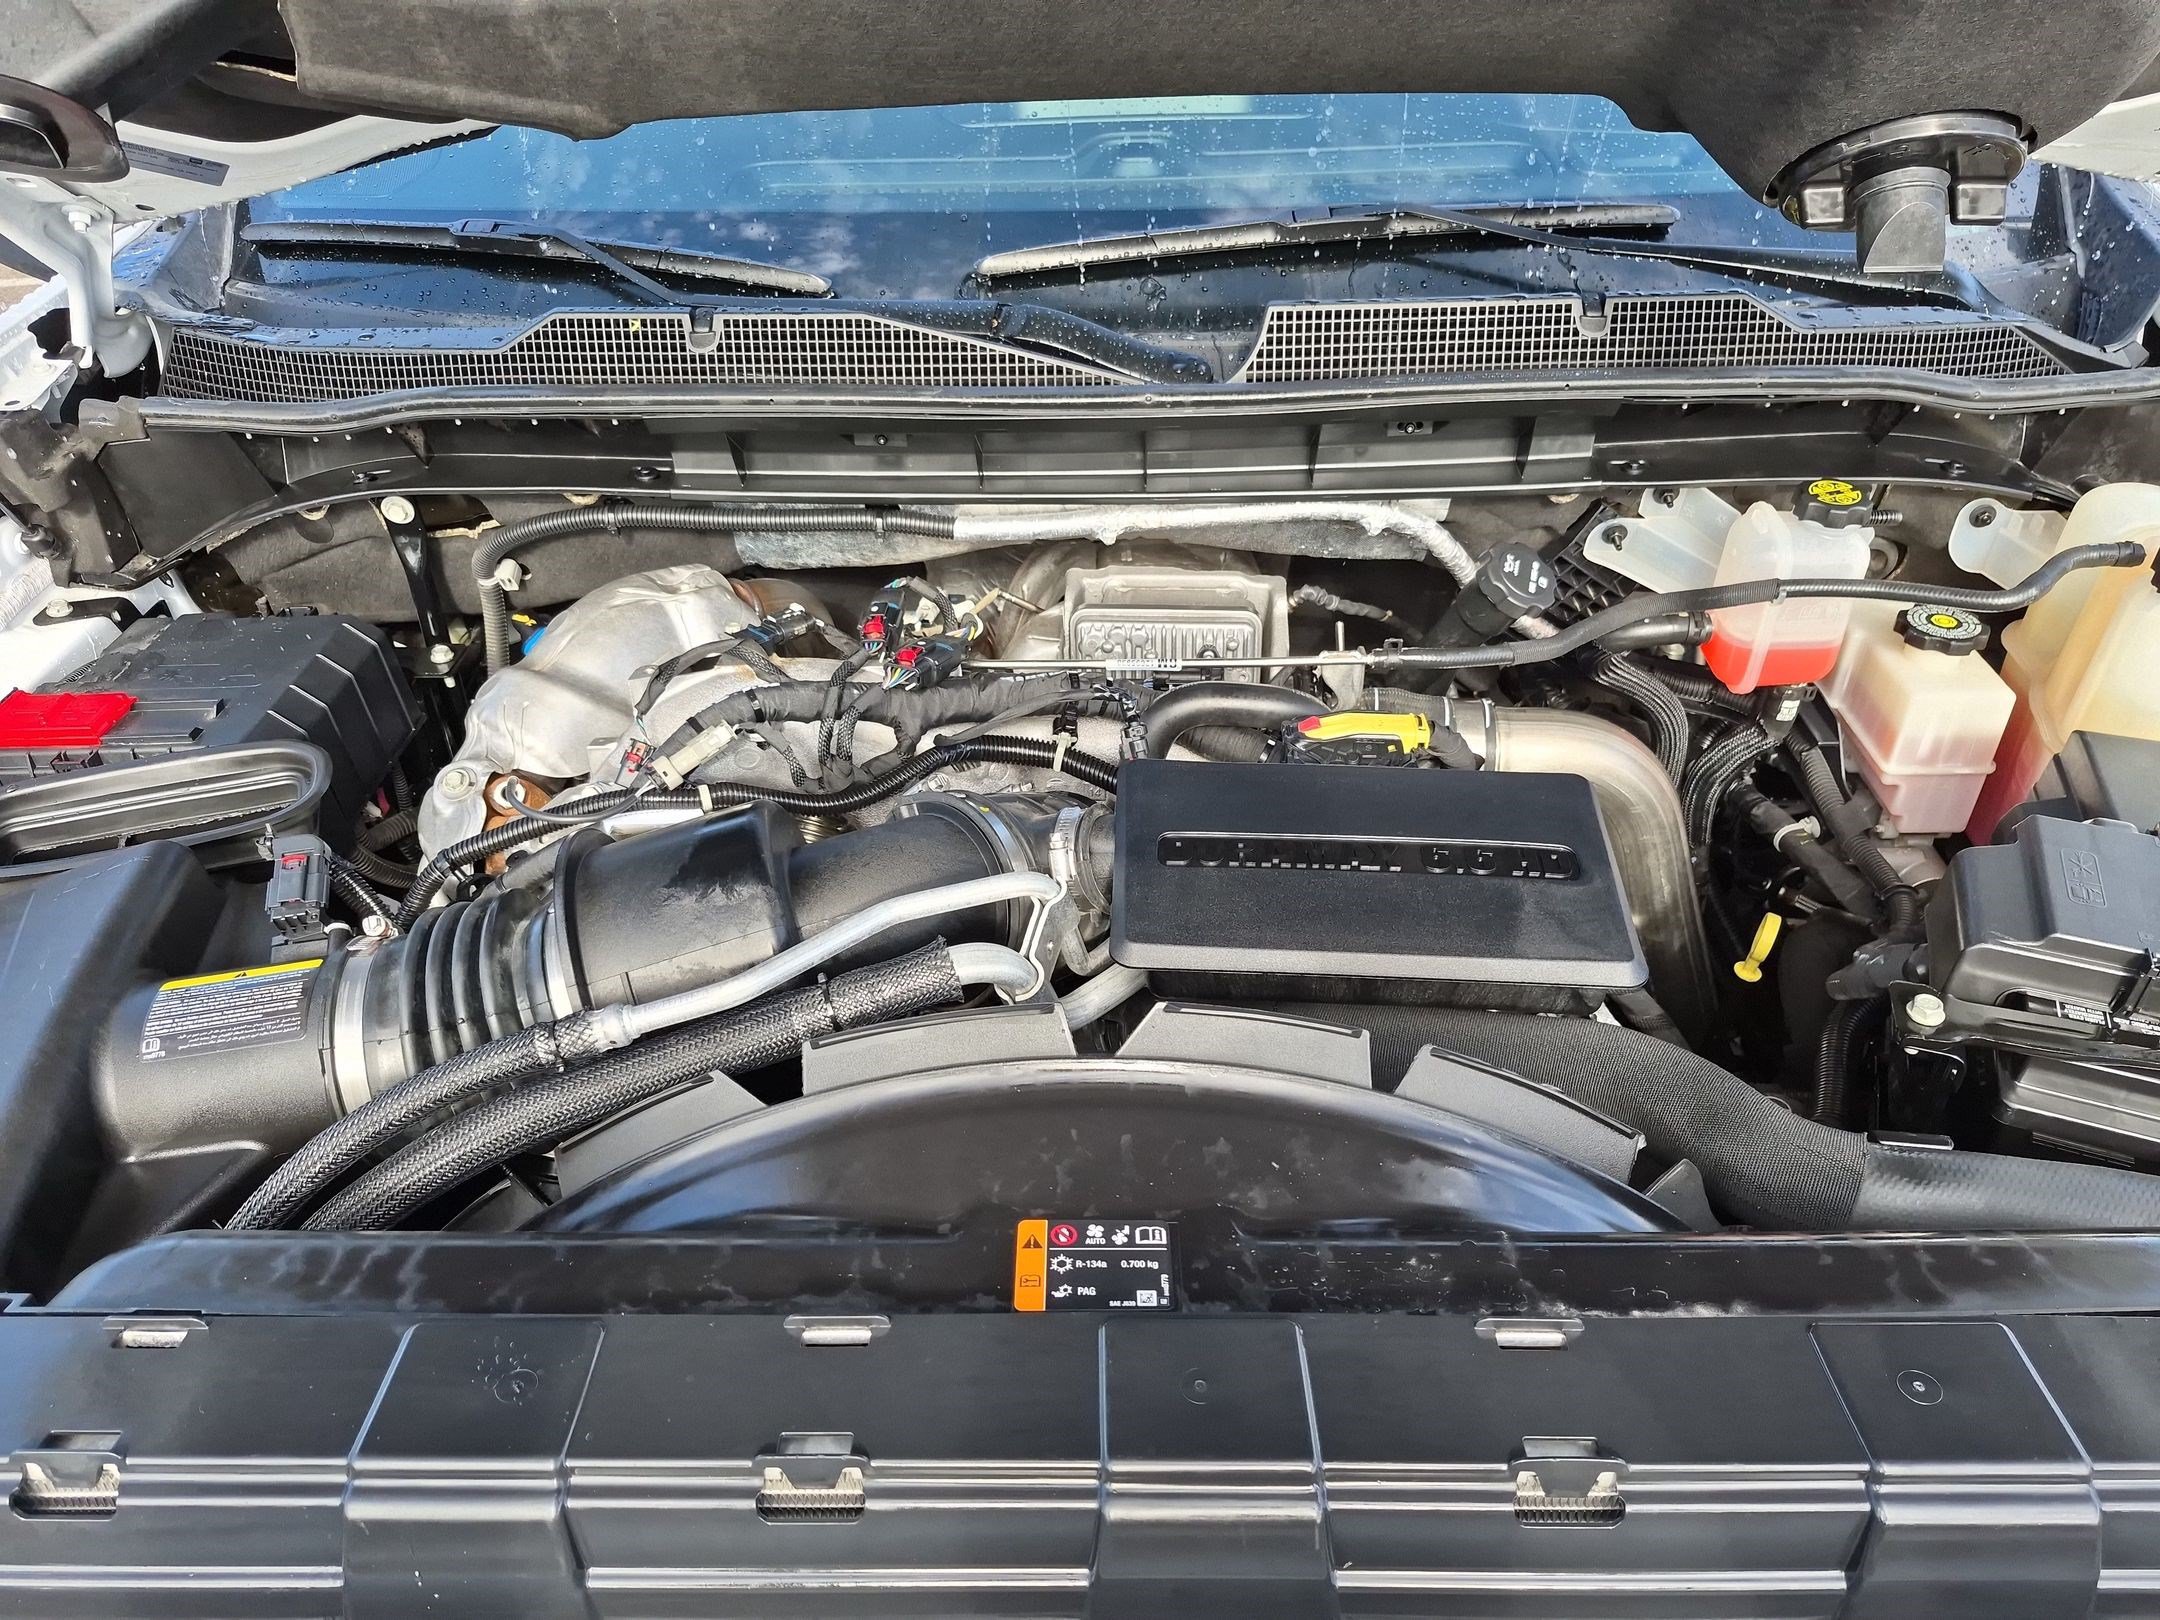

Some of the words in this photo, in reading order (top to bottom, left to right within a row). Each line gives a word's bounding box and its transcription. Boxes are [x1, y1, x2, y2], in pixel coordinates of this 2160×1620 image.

[1085, 1237, 1106, 1245] AUTO
[1075, 1259, 1108, 1268] R-134a
[1121, 1260, 1146, 1268] 0.700
[1147, 1260, 1159, 1270] kg
[1077, 1287, 1096, 1296] PAG
